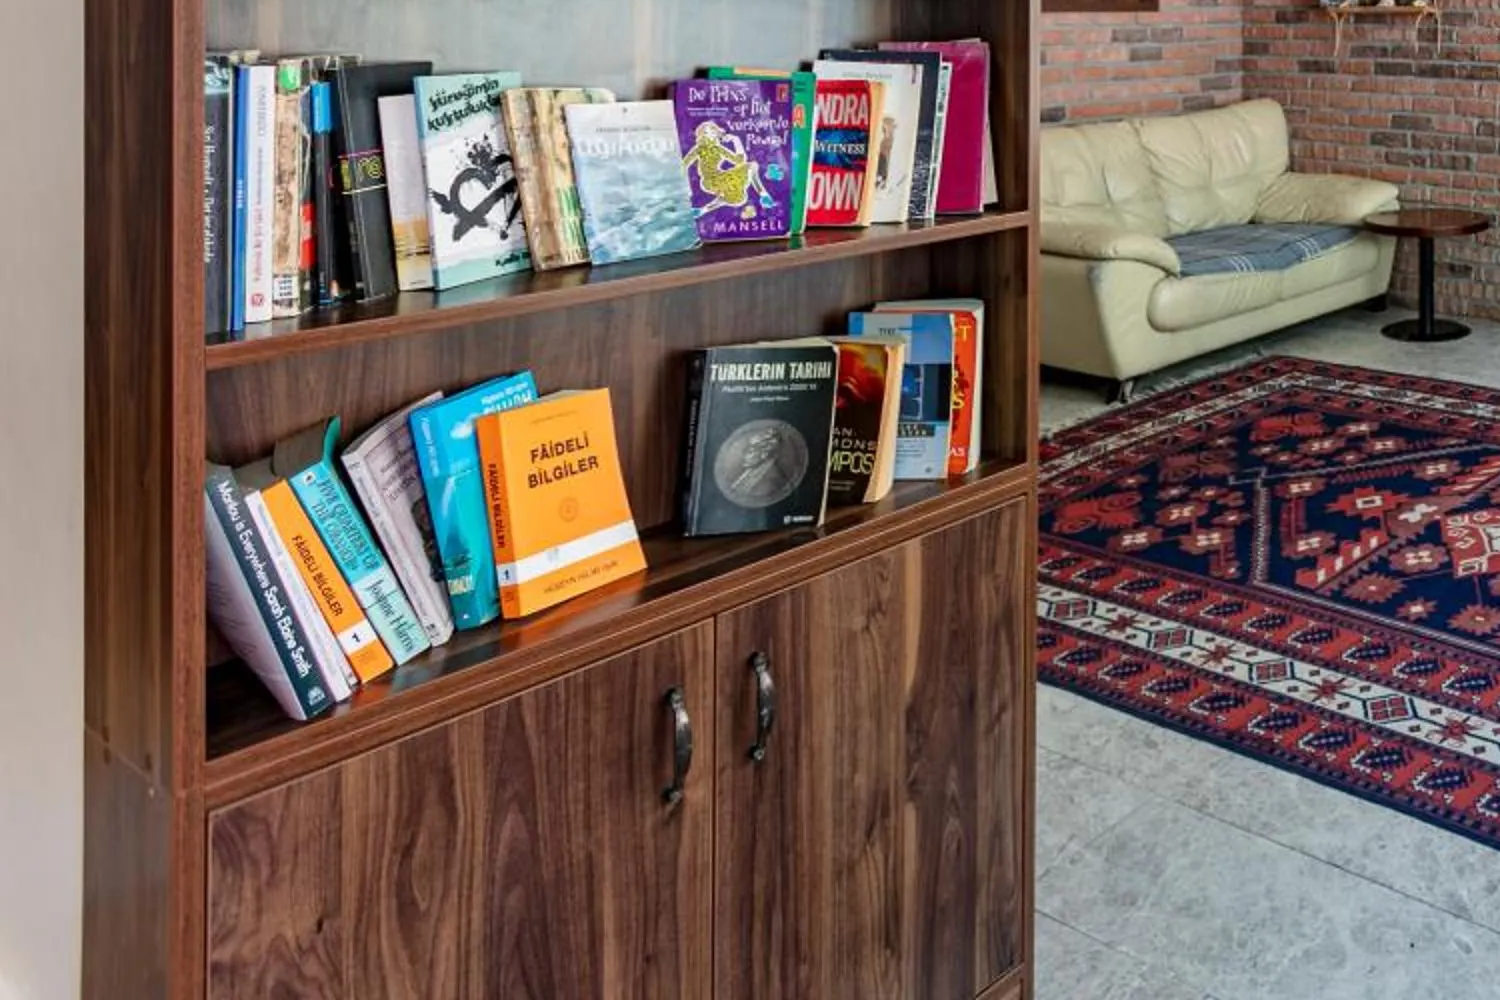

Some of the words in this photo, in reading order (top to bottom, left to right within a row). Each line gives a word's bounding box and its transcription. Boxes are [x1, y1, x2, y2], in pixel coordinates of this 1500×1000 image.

[815, 92, 869, 127] NDRA
[814, 139, 866, 156] WITNESS
[807, 170, 864, 212] OWN
[713, 220, 785, 234] MANSELL
[239, 530, 271, 588] Everywhere
[264, 587, 285, 618] Sarah
[277, 616, 298, 649] Elaine
[289, 647, 311, 678] Smith
